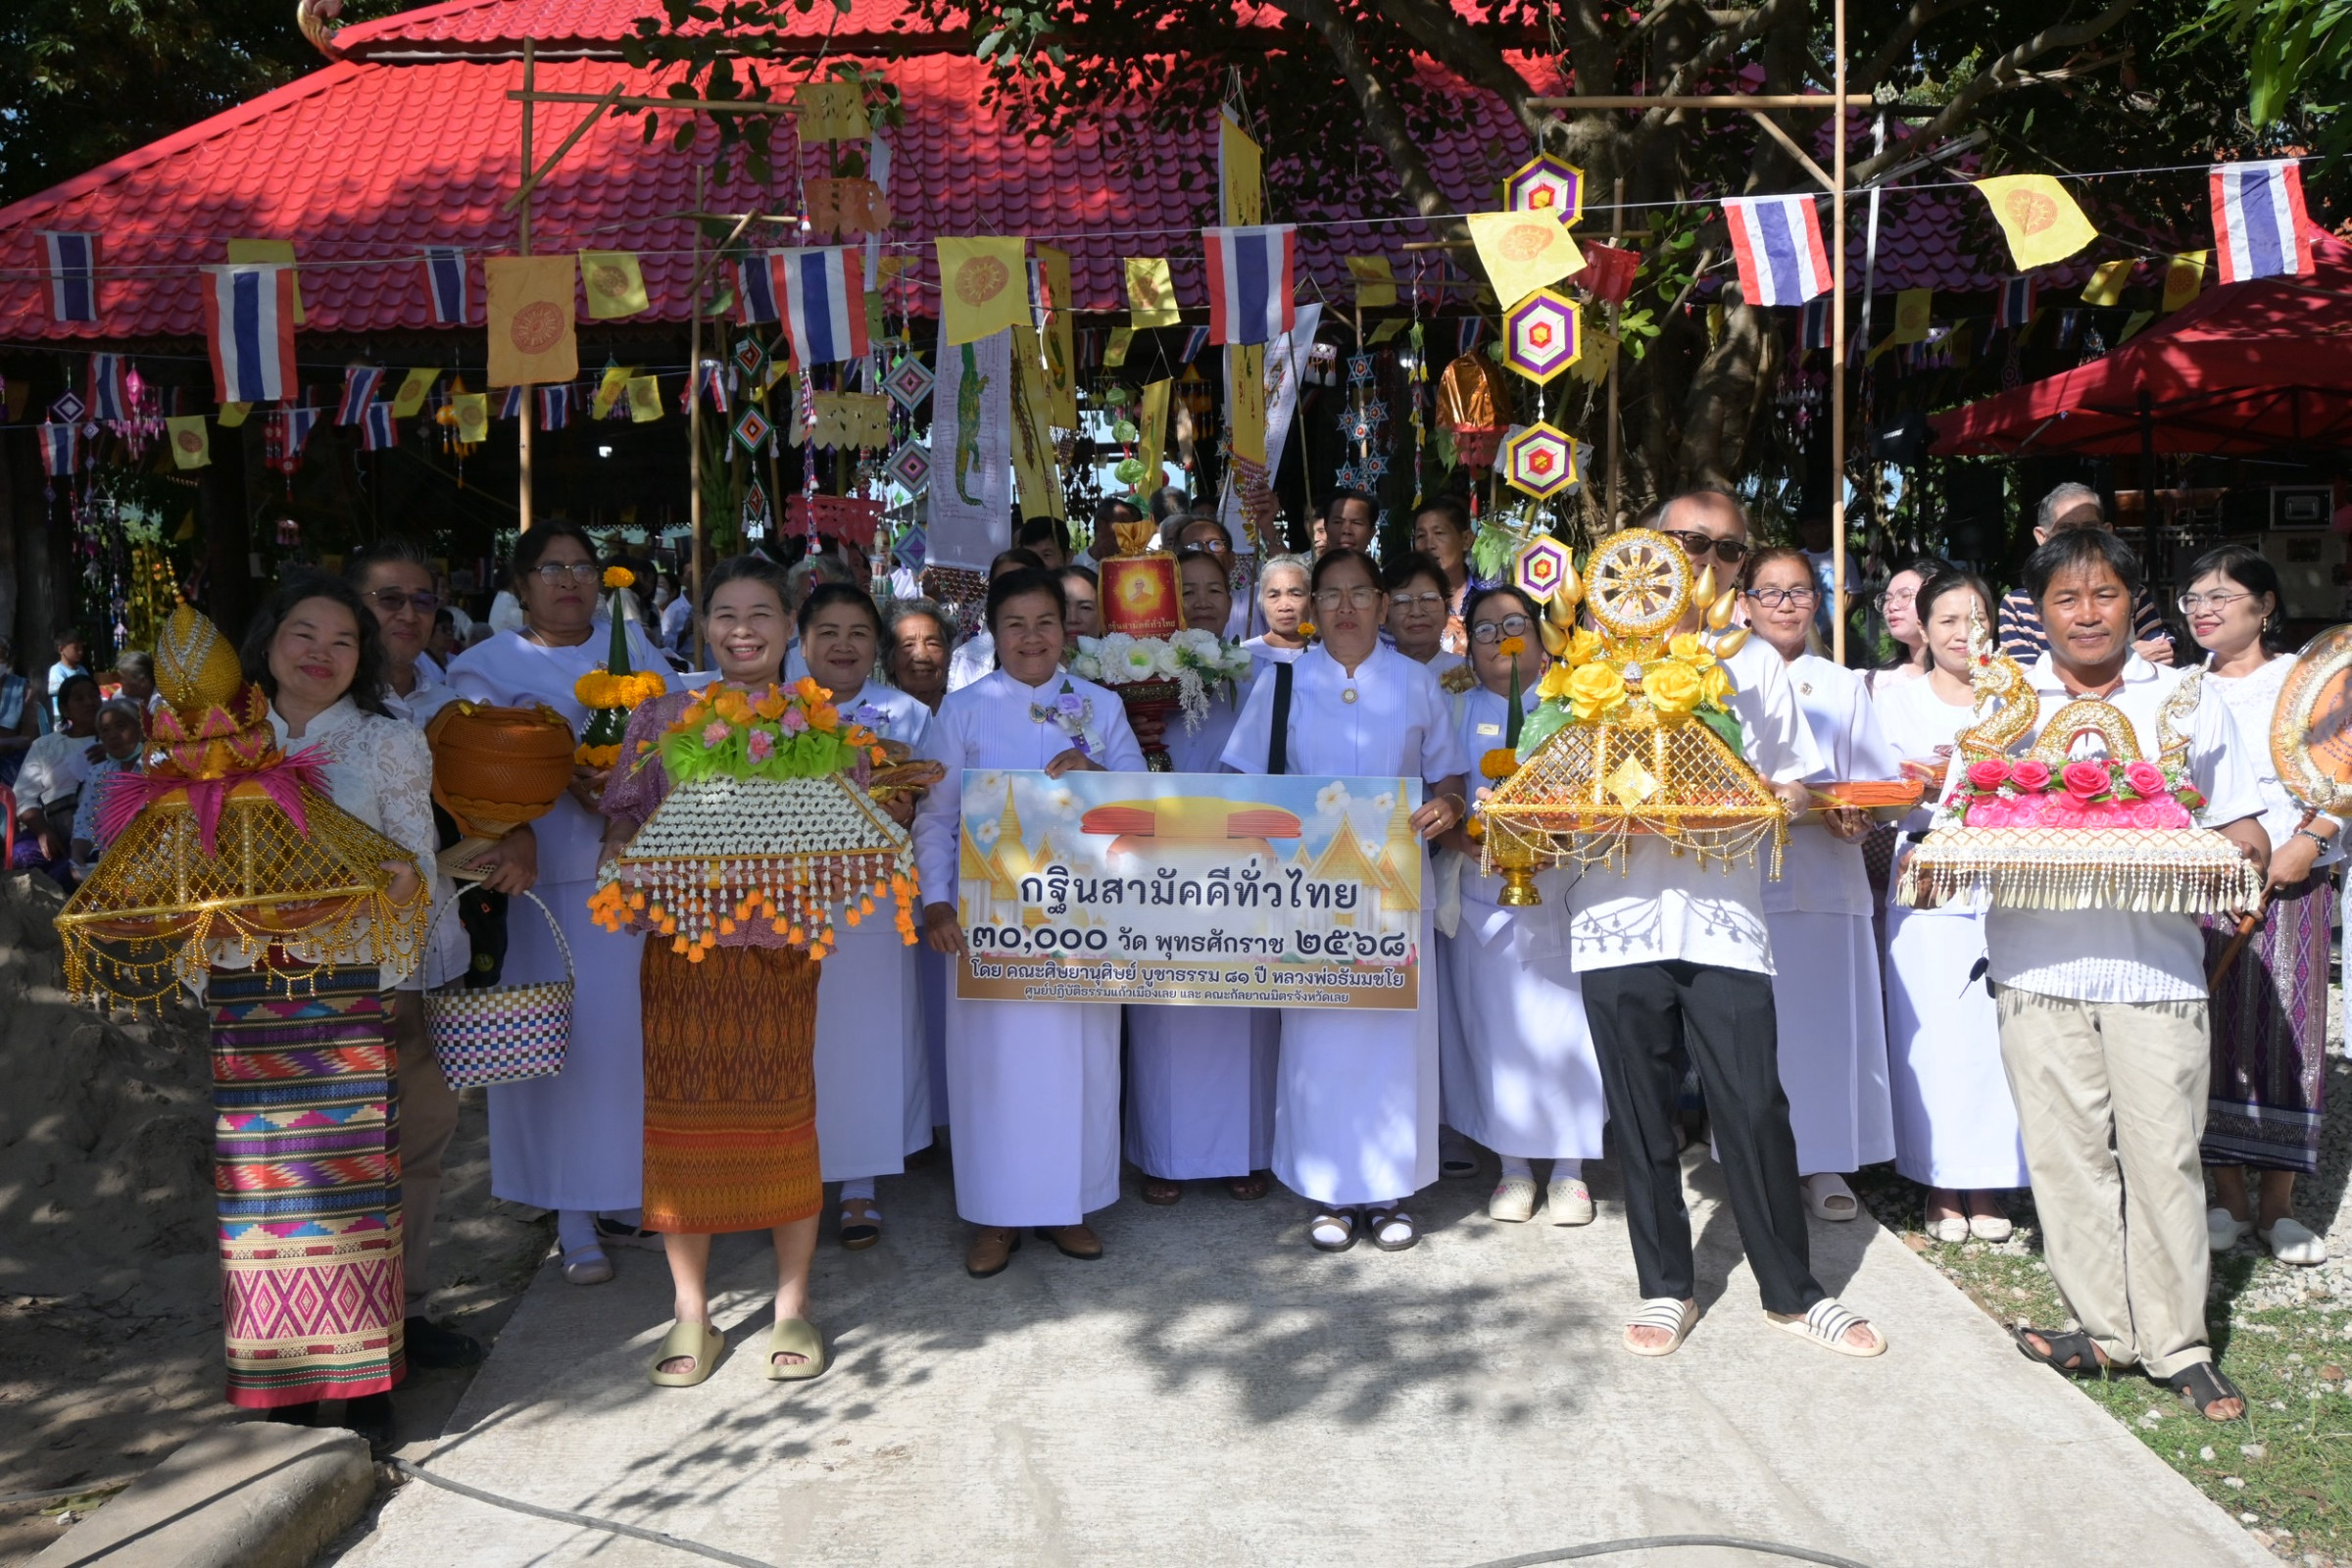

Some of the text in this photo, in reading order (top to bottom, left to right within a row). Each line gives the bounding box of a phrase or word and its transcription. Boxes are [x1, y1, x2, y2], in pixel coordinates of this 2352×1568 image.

[1020, 858, 1357, 915] กฐินสามัคคีทั่วไทย
[972, 926, 1405, 960] ๓๐,๐๐๐ วัด พุทธศักราช ๒๕๖๘
[971, 959, 1405, 988] โดย คณะศิษยานุศิษย์ บูชาธรรม ๘๑ ปี หลวงพ่อธัมมชโย
[1179, 990, 1201, 1000] และ
[1203, 987, 1349, 1004] คณะกัลยาณมิตรจังหวัดเลย
